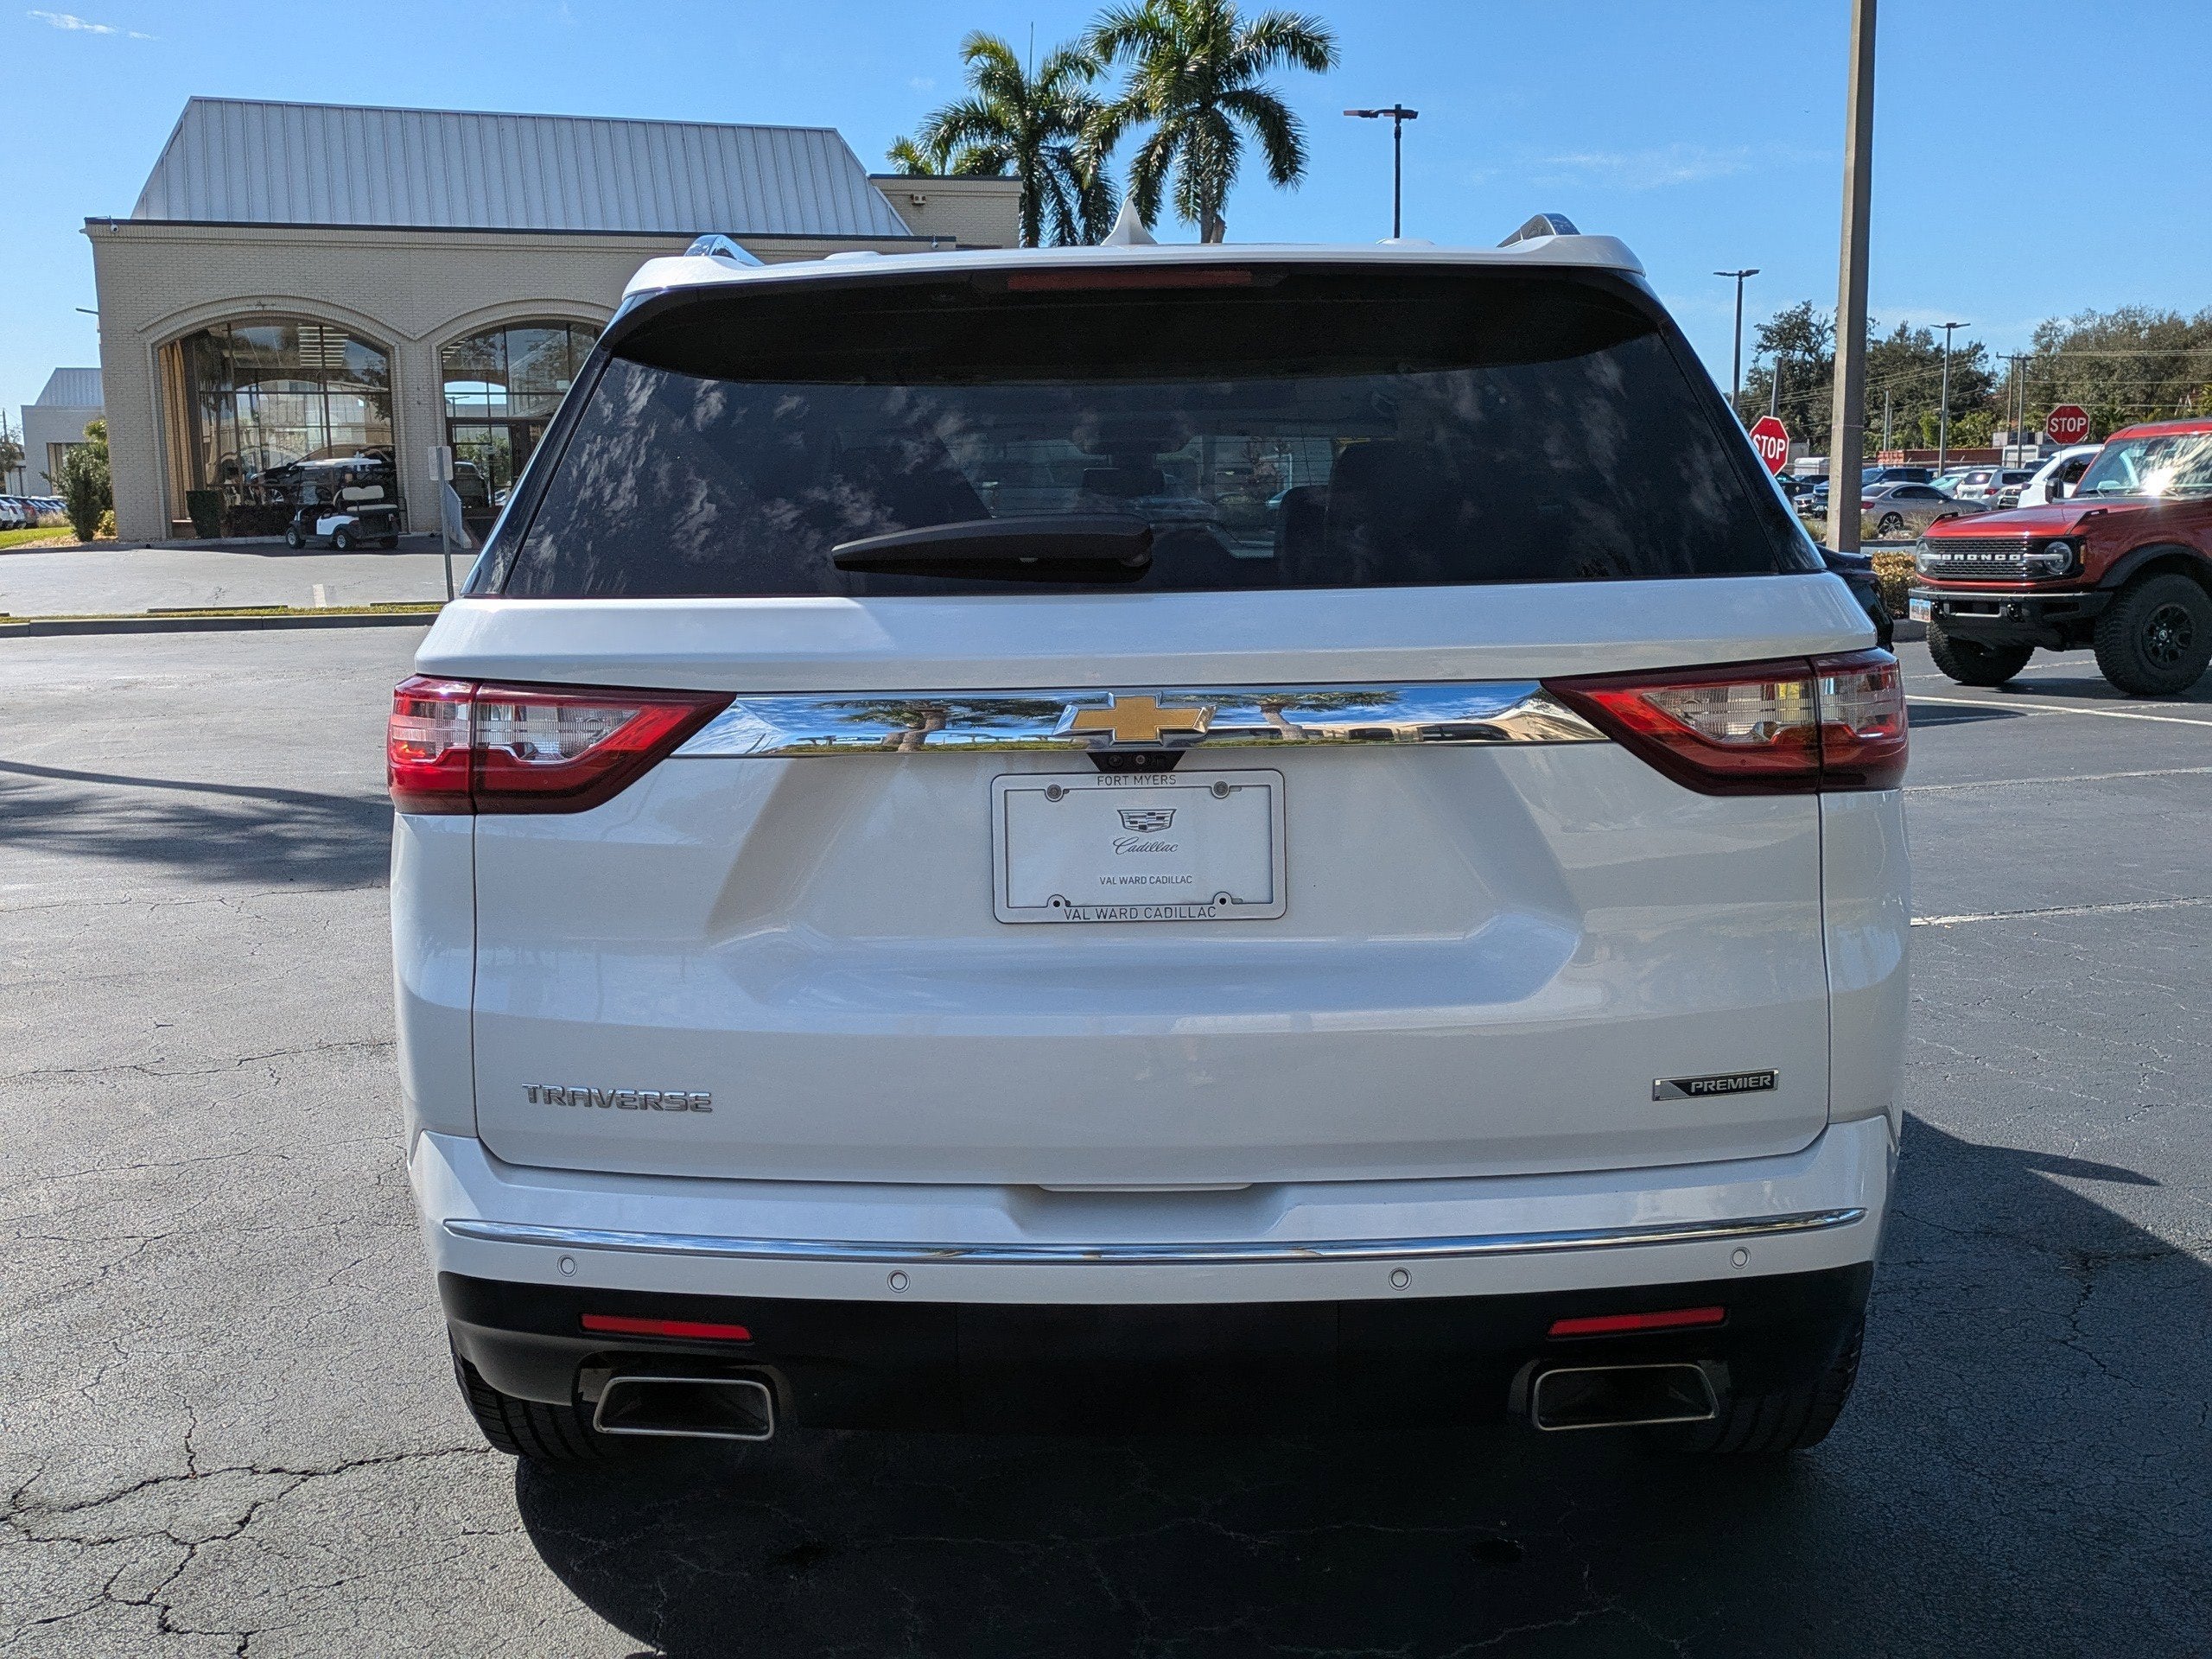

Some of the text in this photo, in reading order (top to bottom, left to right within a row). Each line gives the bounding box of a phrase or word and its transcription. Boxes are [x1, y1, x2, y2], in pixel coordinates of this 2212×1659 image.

[2050, 416, 2087, 432] STOP
[1752, 433, 1786, 460] STOP
[1097, 774, 1177, 786] FORT MYERS
[1112, 836, 1179, 855] Cadillac
[1099, 874, 1192, 886] VAL WARD CADILLAC
[1064, 906, 1217, 920] VAL WARD CADILLAC
[1690, 1075, 1771, 1093] PREMIER
[521, 1083, 713, 1113] TRAVERSE
